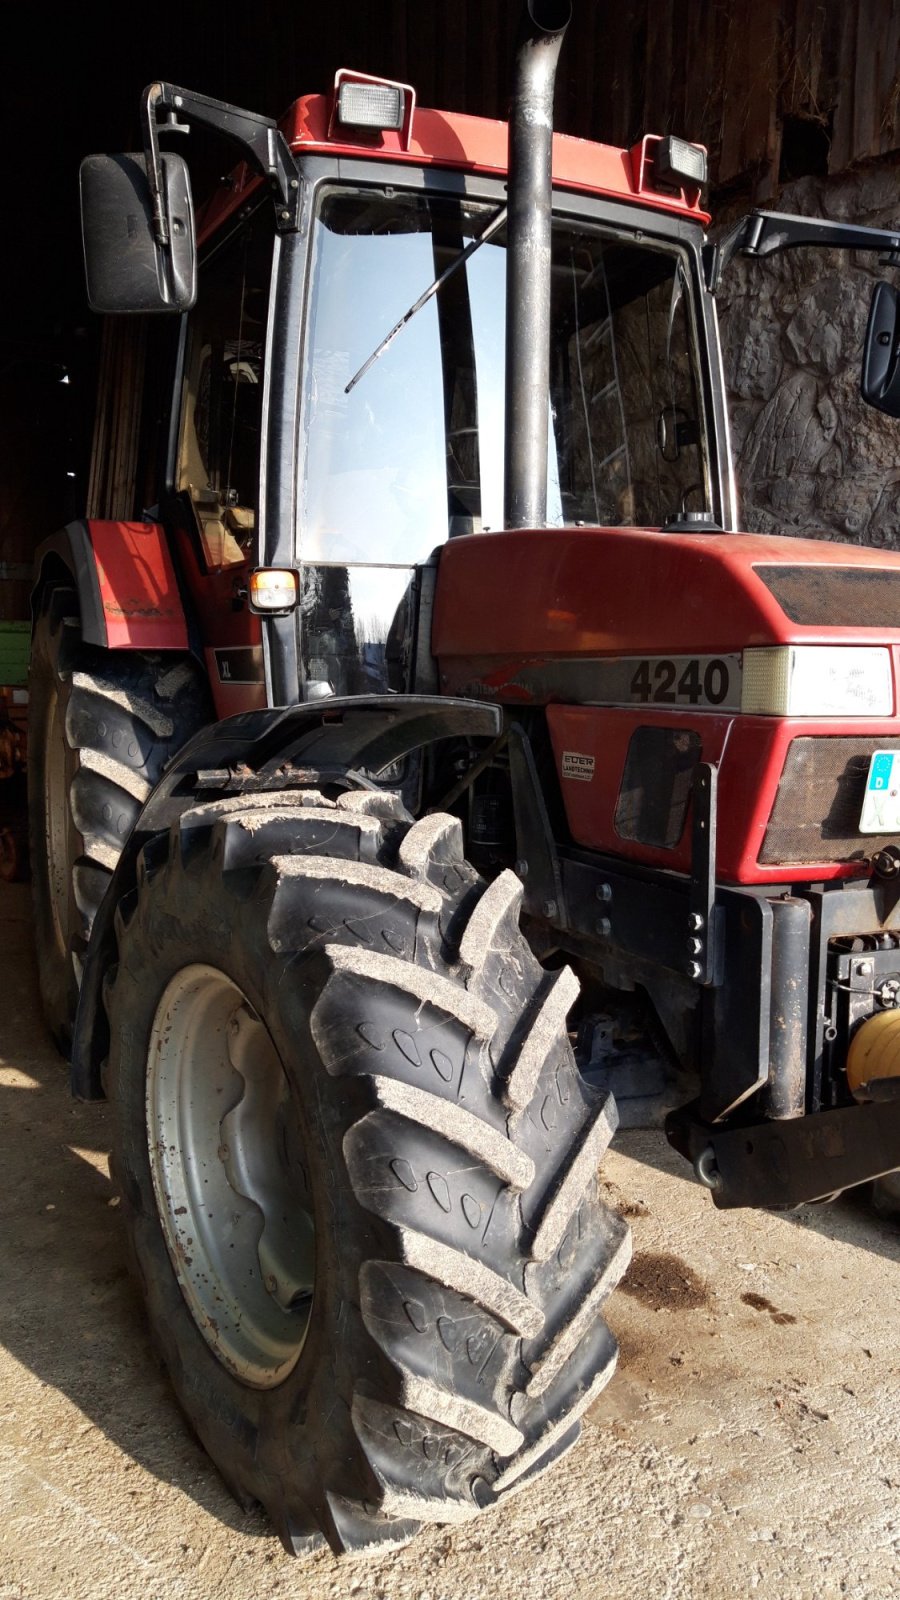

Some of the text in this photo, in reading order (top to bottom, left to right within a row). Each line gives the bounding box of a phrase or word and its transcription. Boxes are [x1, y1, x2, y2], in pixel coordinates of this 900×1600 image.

[629, 659, 730, 705] 4240
[564, 755, 594, 765] EDER
[875, 776, 884, 789] D
